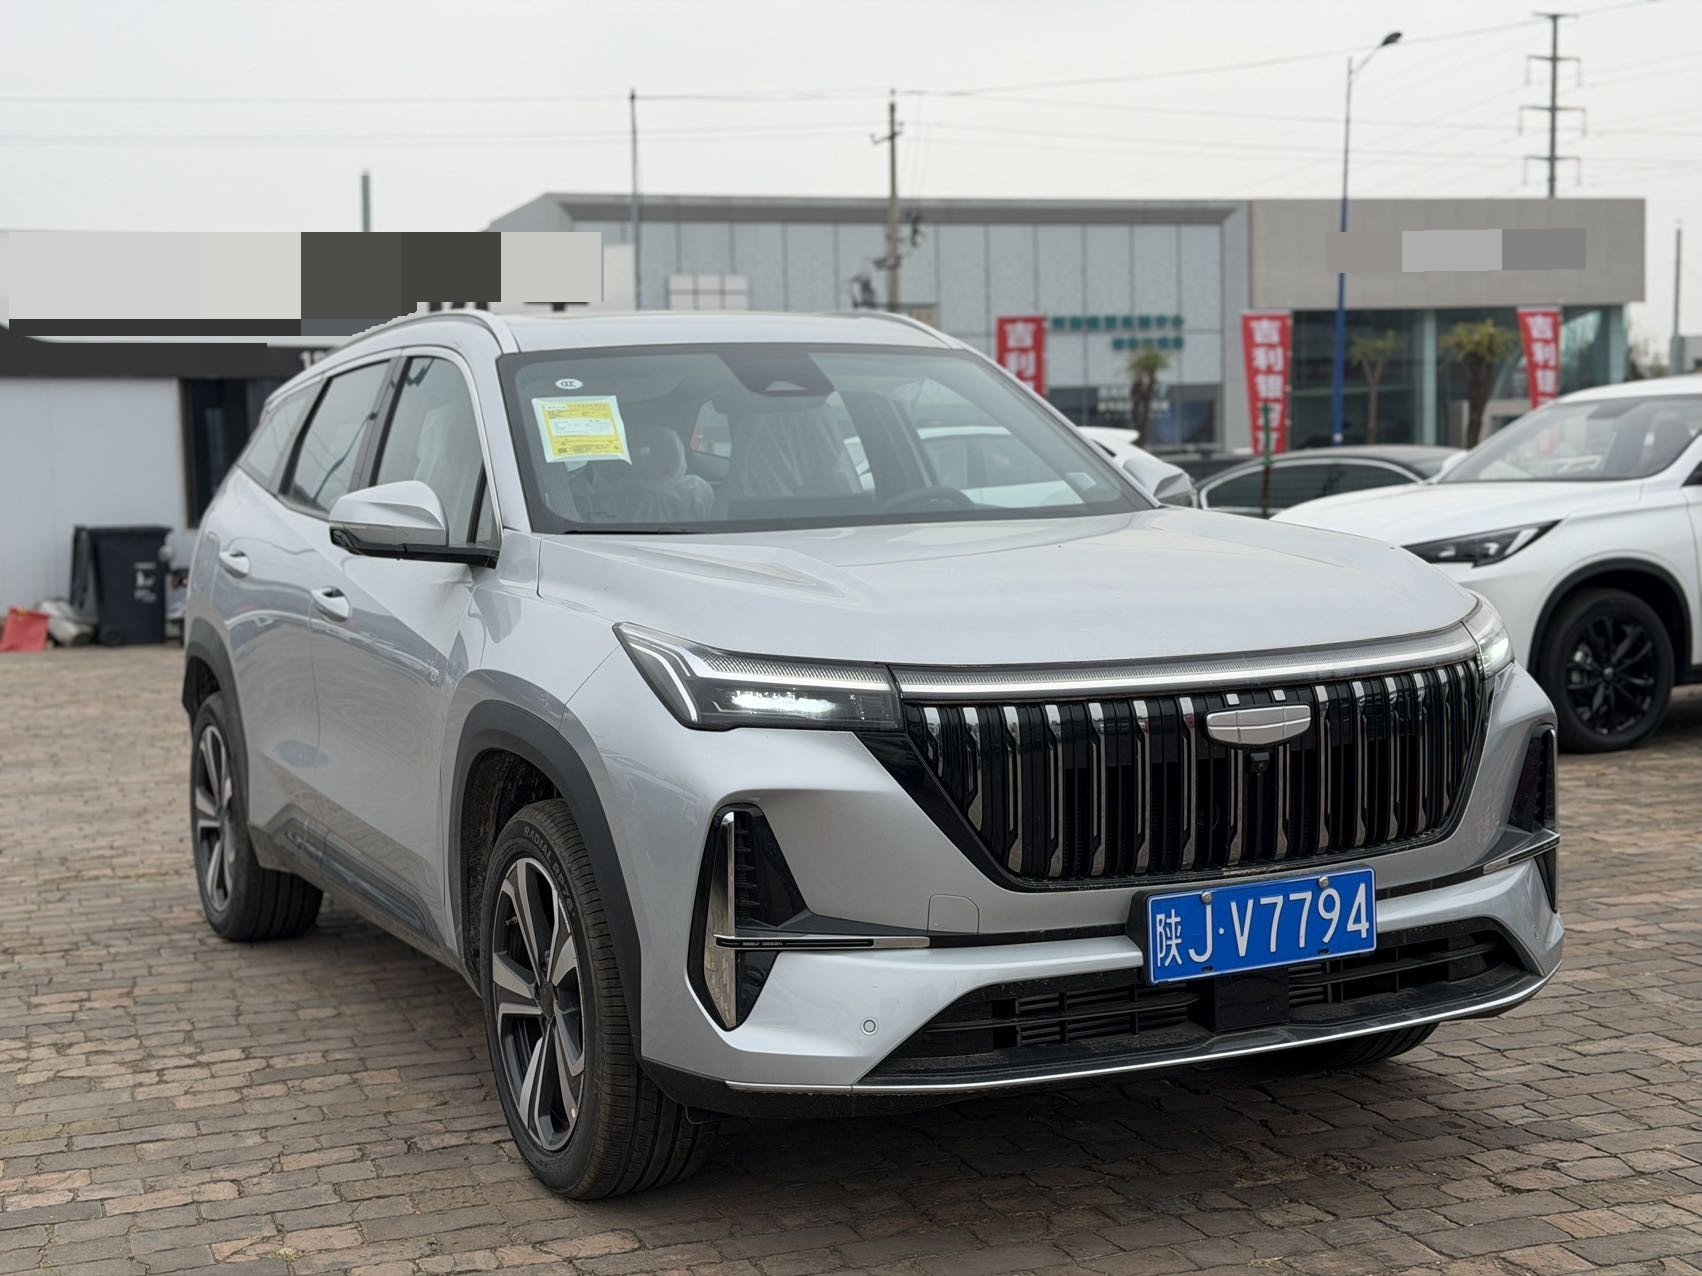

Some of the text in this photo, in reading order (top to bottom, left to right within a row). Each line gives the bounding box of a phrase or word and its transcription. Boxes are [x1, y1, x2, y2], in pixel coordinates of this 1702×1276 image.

[1003, 320, 1038, 389] 吉利
[1525, 314, 1557, 404] 吉利银
[524, 825, 553, 864] RADIAL
